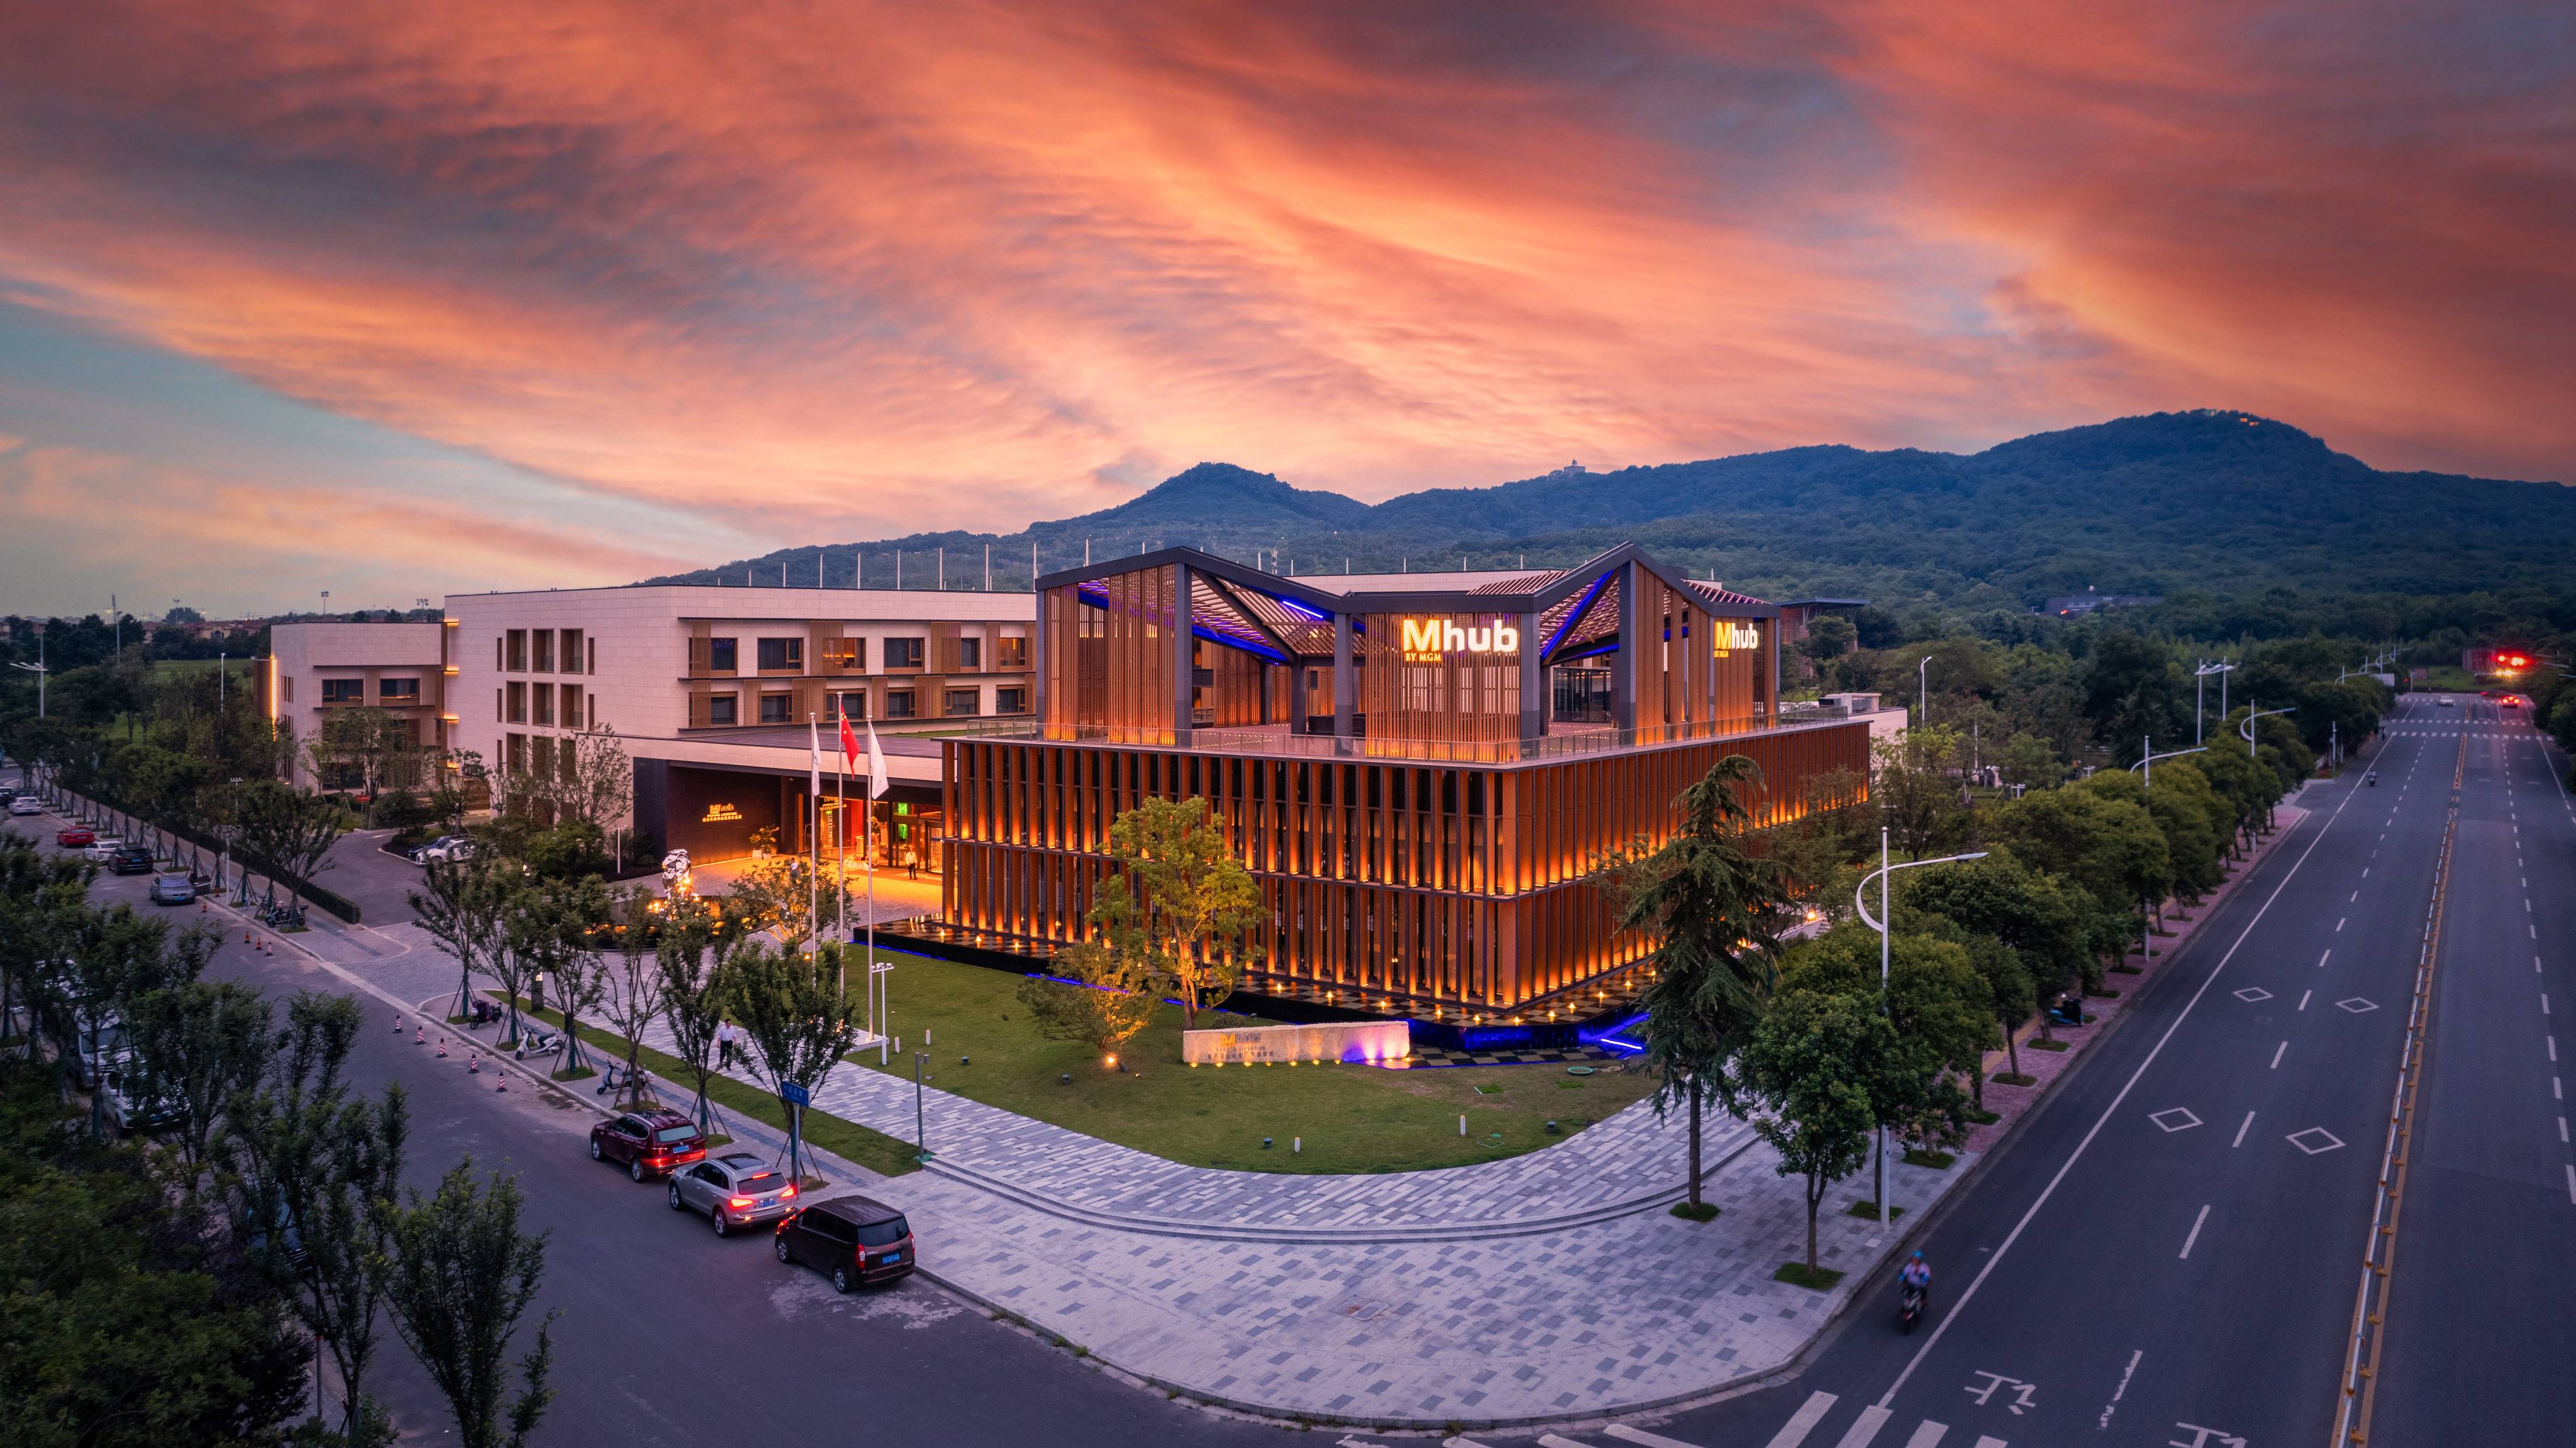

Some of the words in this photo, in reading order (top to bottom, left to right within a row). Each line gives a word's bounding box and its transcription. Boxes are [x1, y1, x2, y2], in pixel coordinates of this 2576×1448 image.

[1403, 619, 1518, 652] Mhub
[1714, 622, 1758, 649] Mhub
[709, 804, 735, 812] Mhub
